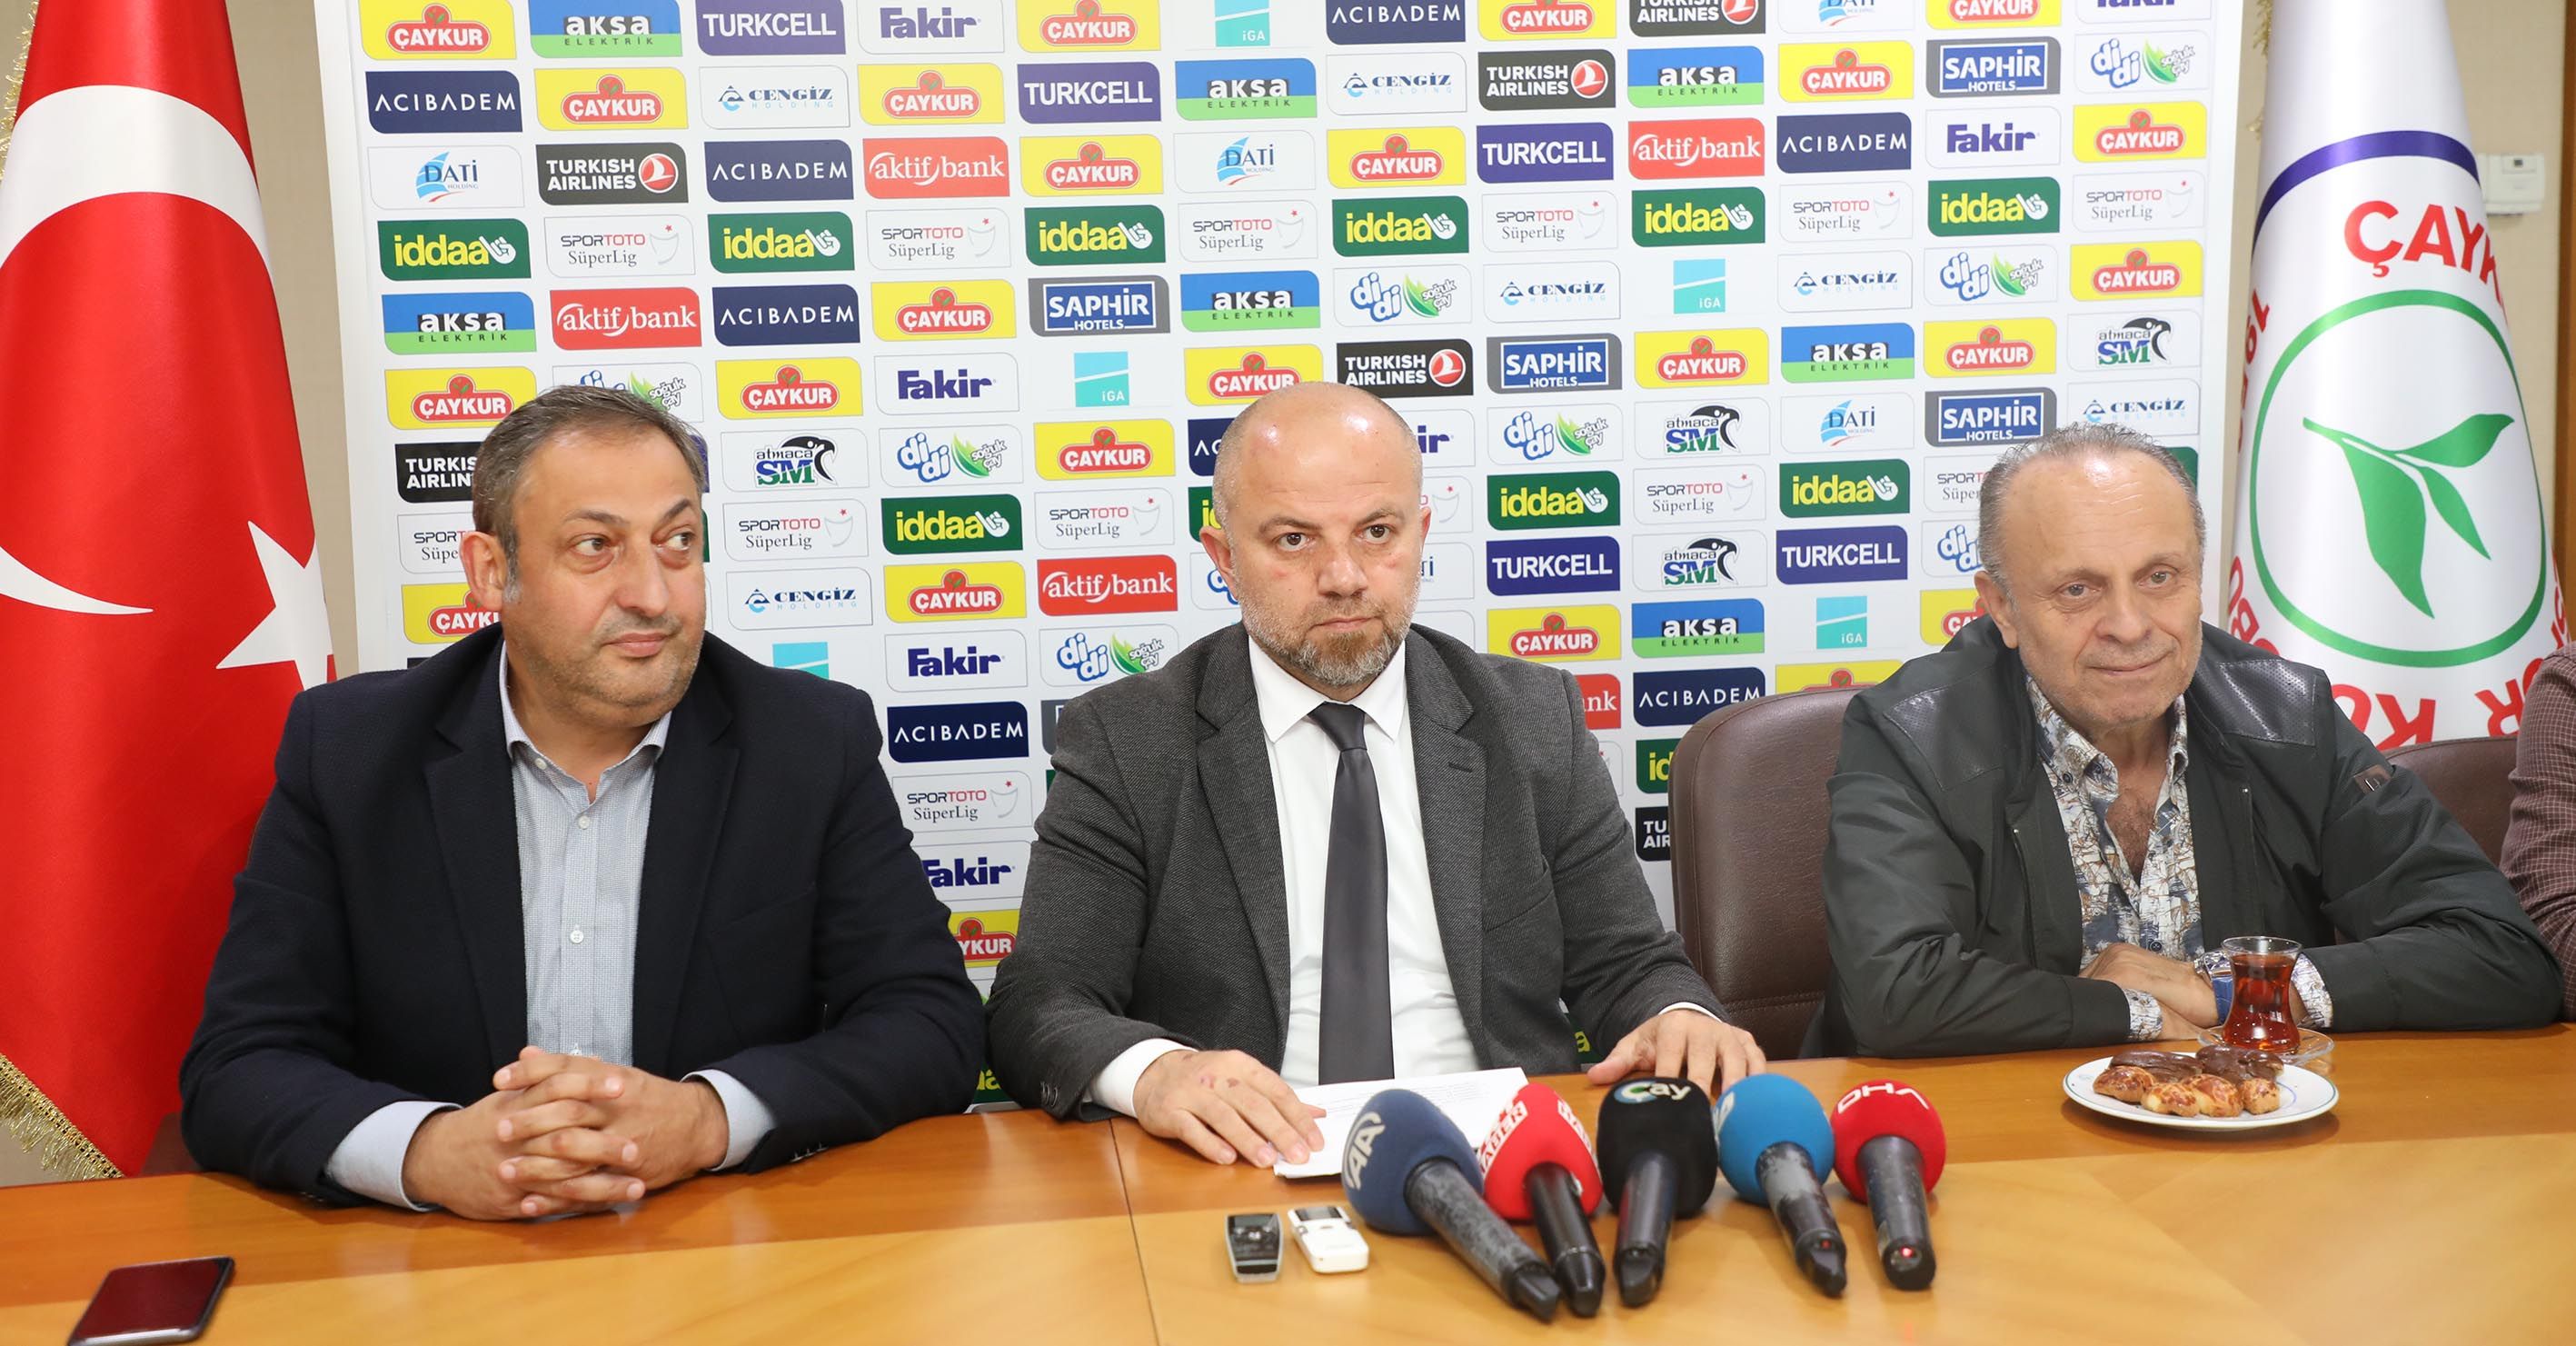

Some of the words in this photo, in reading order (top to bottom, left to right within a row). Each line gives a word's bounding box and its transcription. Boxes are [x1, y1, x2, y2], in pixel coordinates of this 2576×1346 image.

[1332, 6, 1460, 23] ACIBADEM
[1636, 5, 1719, 23] AIRLINES
[1954, 0, 2034, 17] ÇAYKUR
[566, 14, 651, 35] aksa
[703, 14, 836, 37] TURKCELL
[880, 6, 977, 38] Fakir
[1507, 9, 1587, 30] ÇAYKUR
[394, 28, 483, 49] ÇAYKUR
[1048, 22, 1130, 41] ÇAYKUR
[1487, 65, 1568, 81] TURKISH
[1660, 65, 1736, 85] aksa
[1807, 71, 1885, 90] ÇAYKUR
[1025, 82, 1152, 105] TURKCELL
[1209, 78, 1288, 98] aksa
[1487, 80, 1568, 96] AIRLINES
[1968, 81, 2016, 93] HOTELS
[374, 93, 516, 113] ACIBADEM
[569, 99, 656, 120] ÇAYKUR
[890, 93, 974, 114] ÇAYKUR
[1782, 135, 1906, 154] ACIBADEM
[1947, 123, 2036, 153] Fakir
[2102, 130, 2178, 150] ÇAYKUR
[1483, 141, 1606, 165] TURKCELL
[546, 158, 635, 175] TURKISH
[712, 162, 848, 181] ACIBADEM
[1051, 165, 1134, 184] ÇAYKUR
[1357, 155, 1437, 175] ÇAYKUR
[547, 174, 637, 191] AIRLINES
[1645, 202, 1728, 234] iddaa
[1941, 193, 2024, 223] iddaa
[1039, 221, 1128, 252] iddaa
[1347, 212, 1431, 243] iddaa
[394, 234, 489, 266] iddaa
[724, 227, 815, 259] iddaa
[2344, 200, 2509, 325] ÇAYK
[2099, 269, 2174, 289] ÇAYKUR
[1214, 291, 1291, 310] aksa
[421, 313, 502, 334] aksa
[721, 306, 853, 325] ACIBADEM
[903, 308, 986, 328] ÇAYKUR
[1074, 319, 1124, 331] HOTELS
[2099, 329, 2153, 342] atmaca
[1813, 341, 1887, 362] aksa
[1951, 347, 2028, 366] ÇAYKUR
[1345, 355, 1426, 370] TURKISH
[1663, 358, 1740, 377] ÇAYKUR
[898, 369, 991, 400] Fakir
[1346, 369, 1427, 386] AIRLINES
[1530, 376, 1577, 387] HOTELS
[748, 387, 832, 407] ÇAYKUR
[419, 398, 506, 419] ÇAYKUR
[1666, 415, 1718, 429] atmaca
[1966, 430, 2014, 441] HOTELS
[406, 457, 475, 473] TURKIS
[756, 448, 813, 462] atmaca
[1065, 448, 1146, 468] ÇAYKUR
[406, 473, 472, 488] AIRLIN
[1793, 475, 1874, 505] iddaa
[1500, 487, 1584, 517] iddaa
[897, 511, 984, 542] iddaa
[414, 531, 466, 544] SPORT
[1664, 549, 1717, 562] atmaca
[1782, 543, 1900, 569] TURKCELL
[1493, 554, 1613, 578] TURKCELL
[915, 591, 999, 611] ÇAYKUR
[436, 613, 499, 633] ÇAYK
[1664, 617, 1737, 639] aksa
[1517, 632, 1593, 652] ÇAYKUR
[908, 644, 1000, 677] Fakir
[1638, 688, 1760, 707] ACIBADEM
[894, 722, 1023, 743] ACIBADEM
[958, 937, 1011, 956] YKUR
